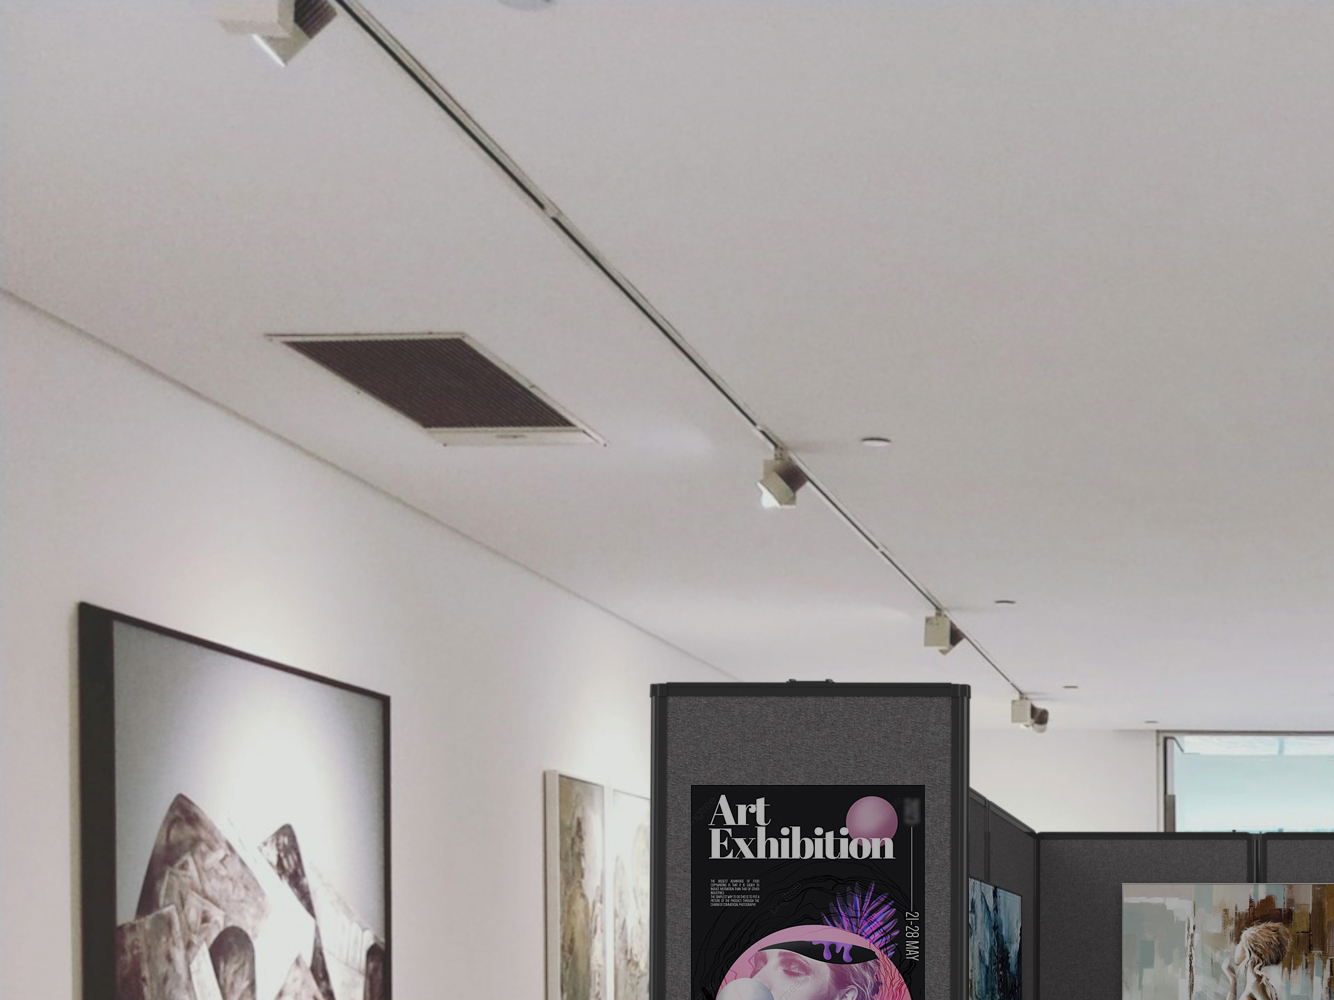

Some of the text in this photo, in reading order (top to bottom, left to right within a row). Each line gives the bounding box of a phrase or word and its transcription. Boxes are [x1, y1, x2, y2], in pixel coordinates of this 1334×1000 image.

[708, 794, 772, 826] Art
[708, 825, 896, 860] Exhibition
[905, 911, 920, 961] 21-28 MAY
